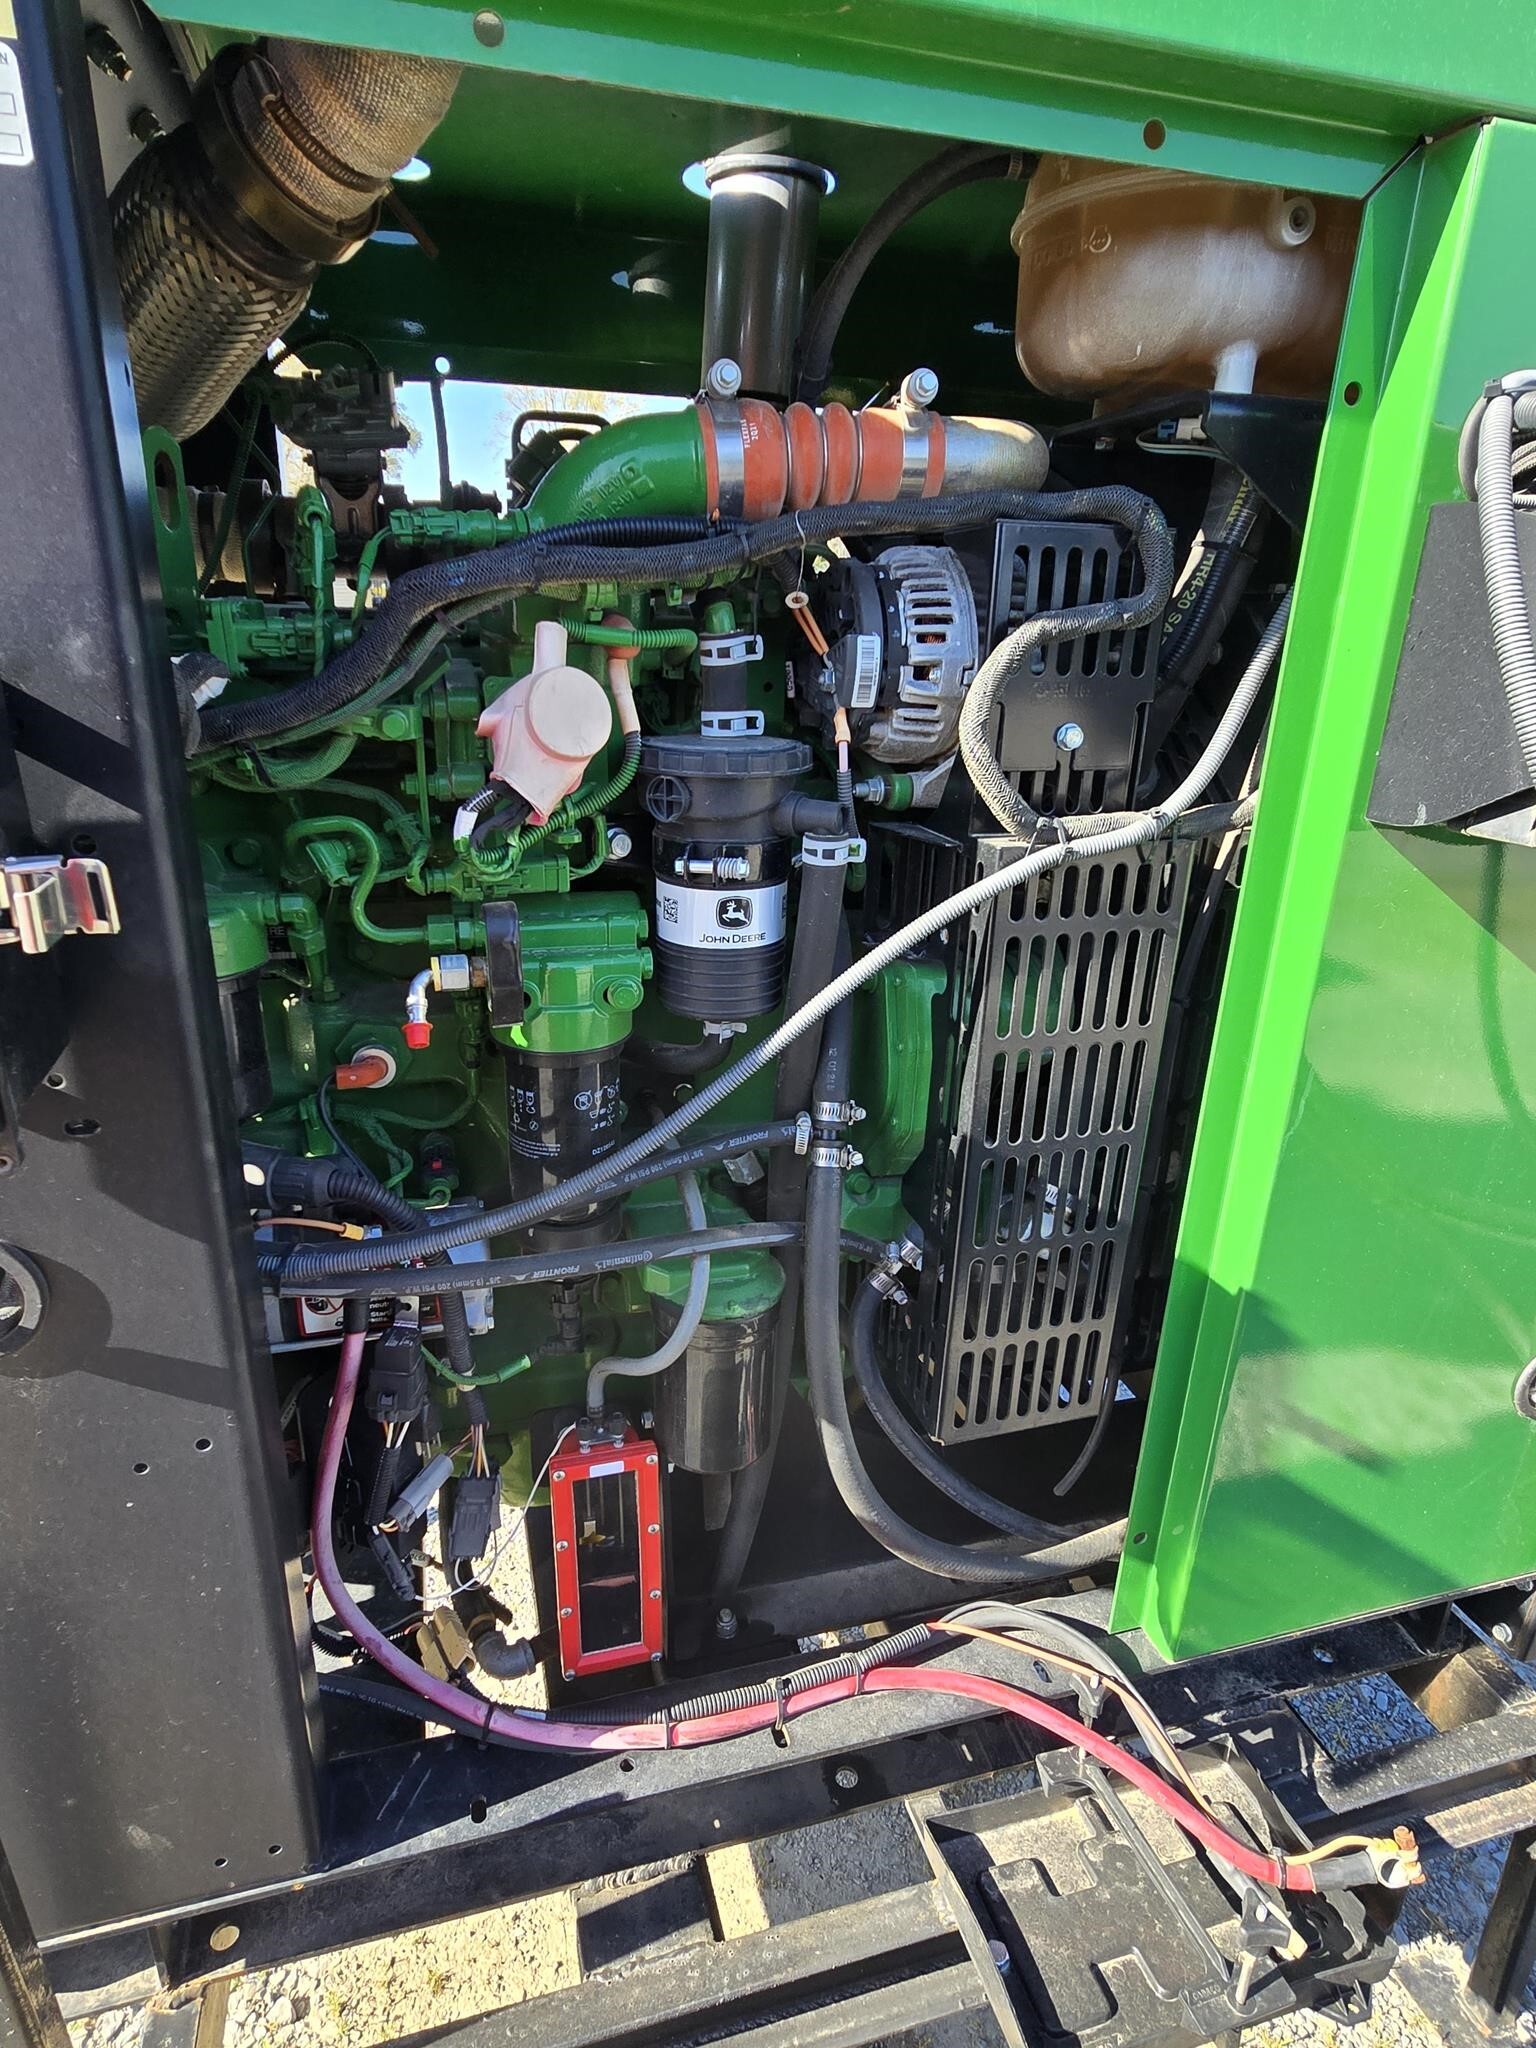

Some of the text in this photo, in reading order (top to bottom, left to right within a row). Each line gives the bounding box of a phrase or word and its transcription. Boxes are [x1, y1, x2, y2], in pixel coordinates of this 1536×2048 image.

[699, 932, 767, 944] JOHN DEERE
[727, 1130, 769, 1147] FRONTIER
[602, 1250, 652, 1268] Continental
[531, 1265, 580, 1278] FRONTIER
